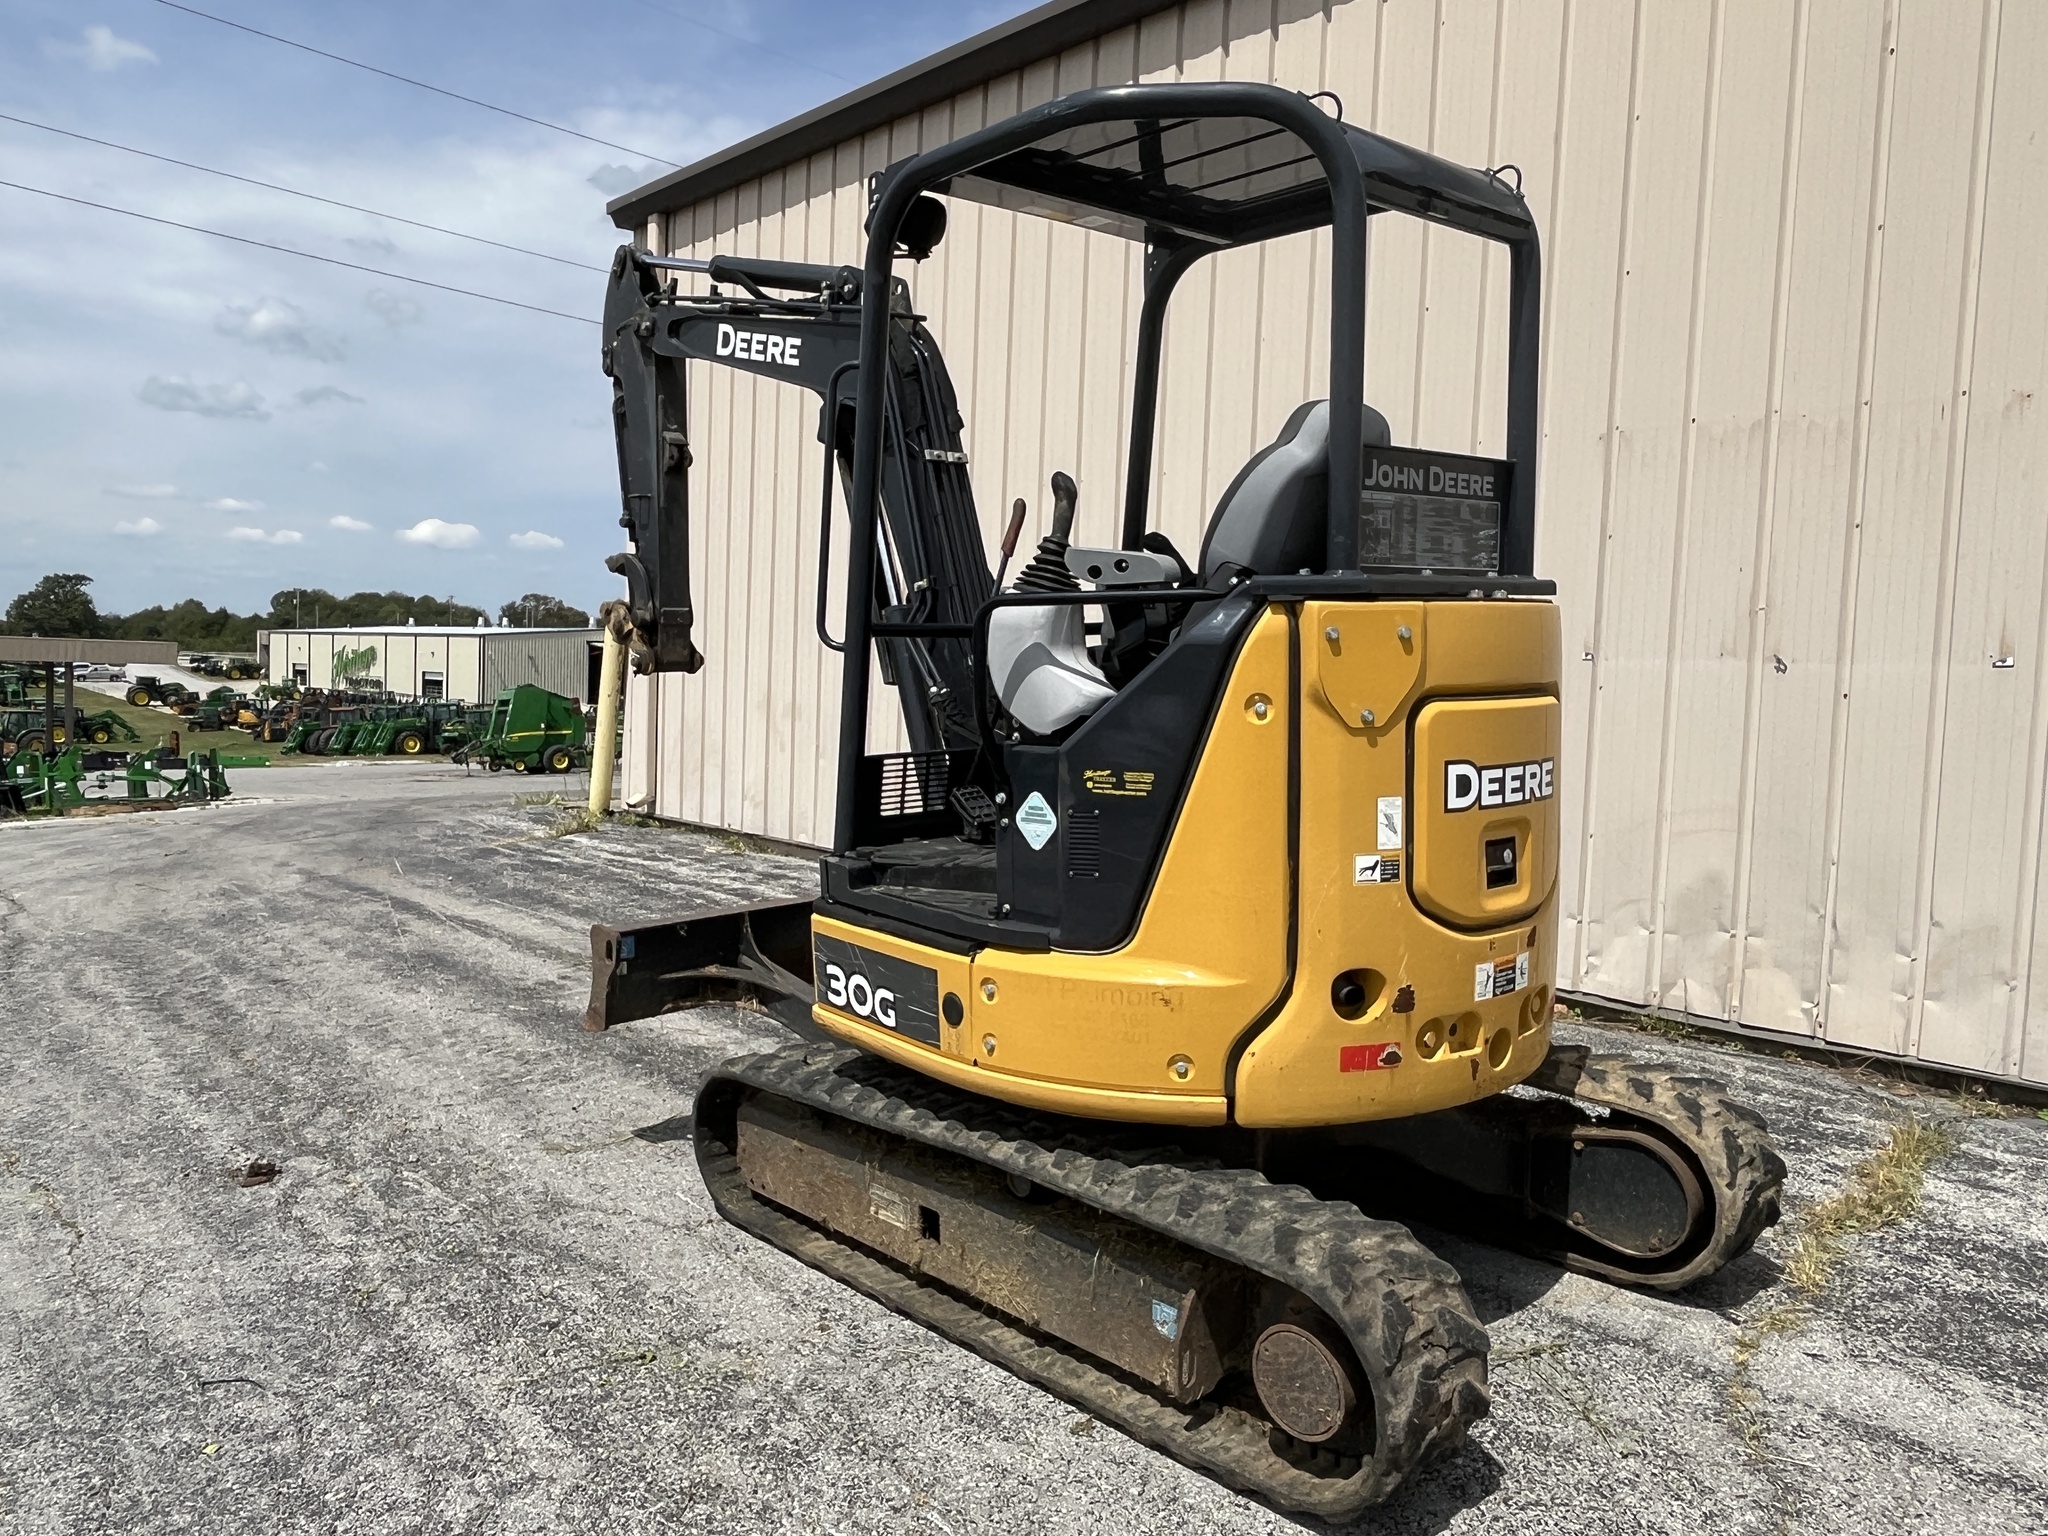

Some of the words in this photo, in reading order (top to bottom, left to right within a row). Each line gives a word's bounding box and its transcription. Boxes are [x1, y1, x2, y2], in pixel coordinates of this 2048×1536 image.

[716, 323, 802, 366] DEERE
[1365, 459, 1424, 491] JOHN
[1429, 465, 1495, 497] DEERE
[1446, 760, 1554, 811] DEERE
[826, 964, 897, 1028] 30G
